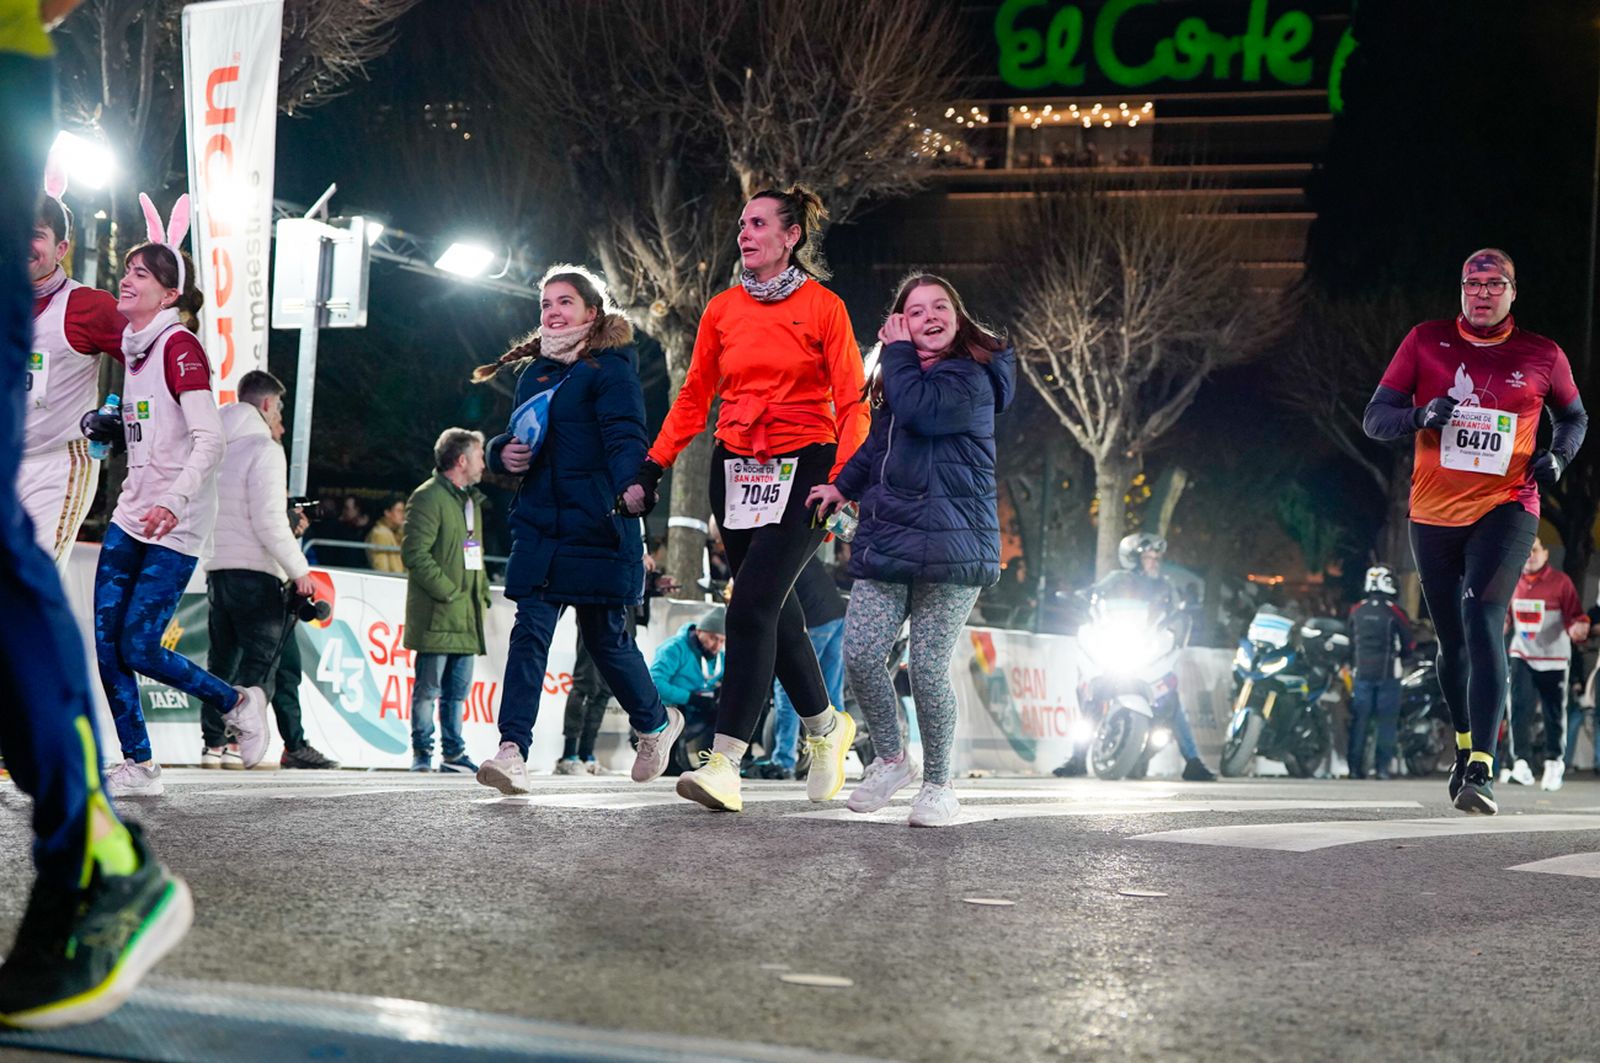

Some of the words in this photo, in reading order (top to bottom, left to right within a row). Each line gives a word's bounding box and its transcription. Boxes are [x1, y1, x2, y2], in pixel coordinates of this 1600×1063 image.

[994, 0, 1086, 89] El
[1093, 0, 1313, 86] Corte
[1451, 419, 1466, 428] SAN
[1456, 428, 1502, 452] 6470
[734, 474, 749, 483] SAN
[741, 483, 781, 505] 7045
[1011, 665, 1047, 700] SAN
